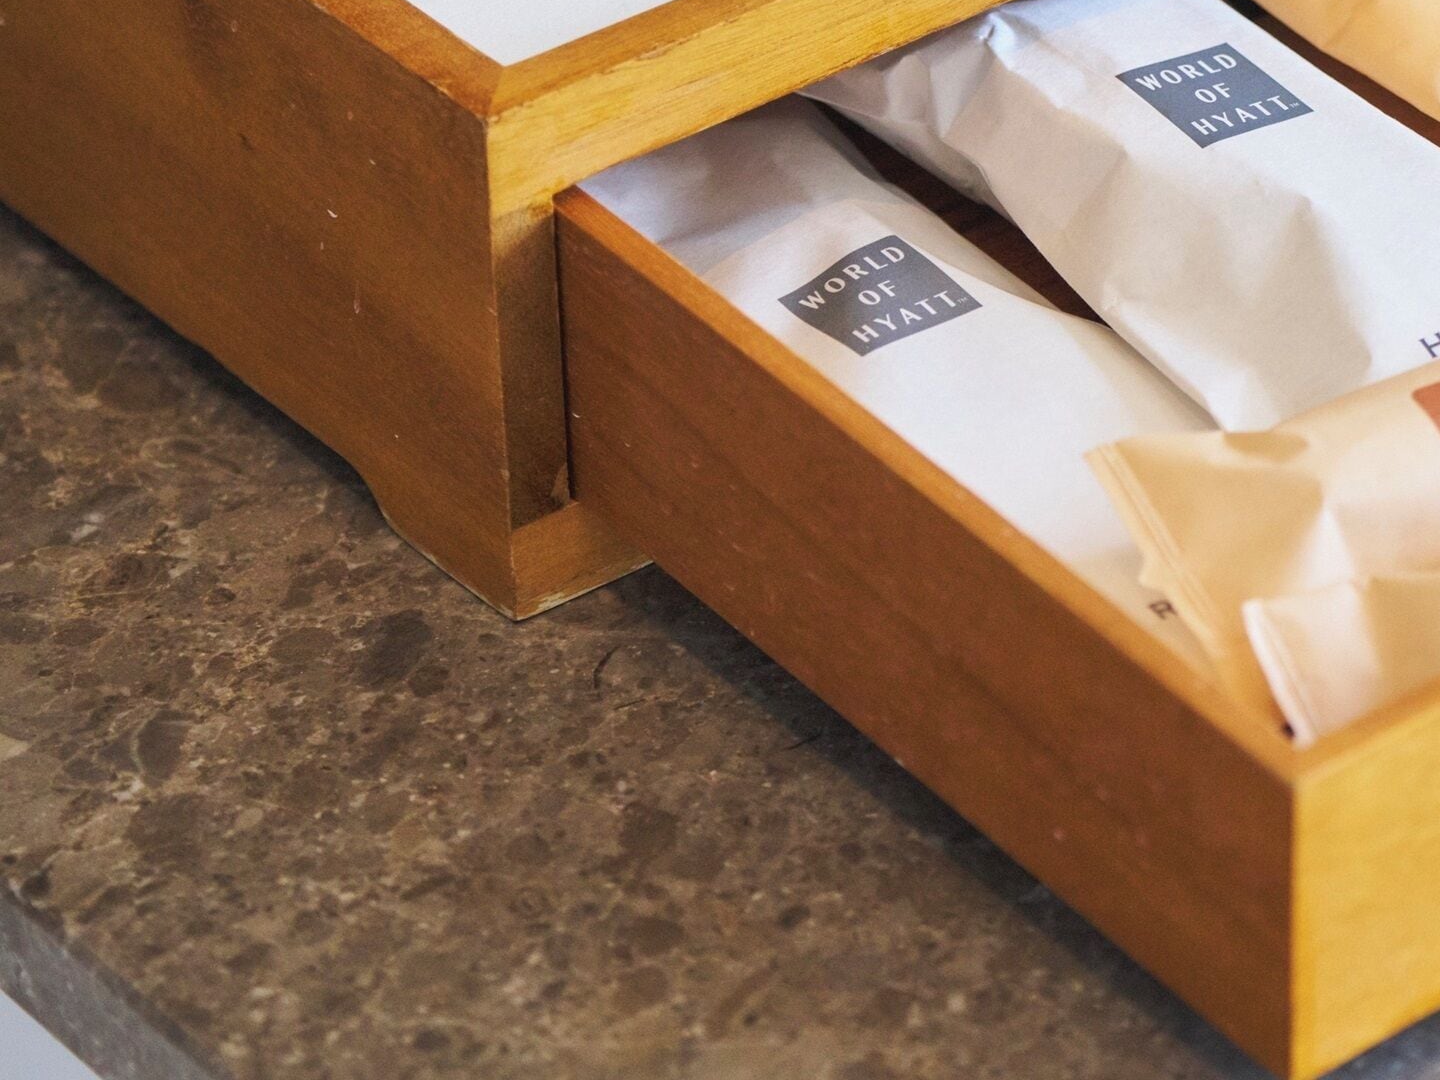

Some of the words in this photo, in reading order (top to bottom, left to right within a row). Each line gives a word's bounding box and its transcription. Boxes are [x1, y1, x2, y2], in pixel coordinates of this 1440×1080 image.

[1136, 51, 1237, 91] WORLD
[1195, 82, 1230, 105] OF
[798, 244, 905, 310] WORLD
[858, 280, 896, 306] OF
